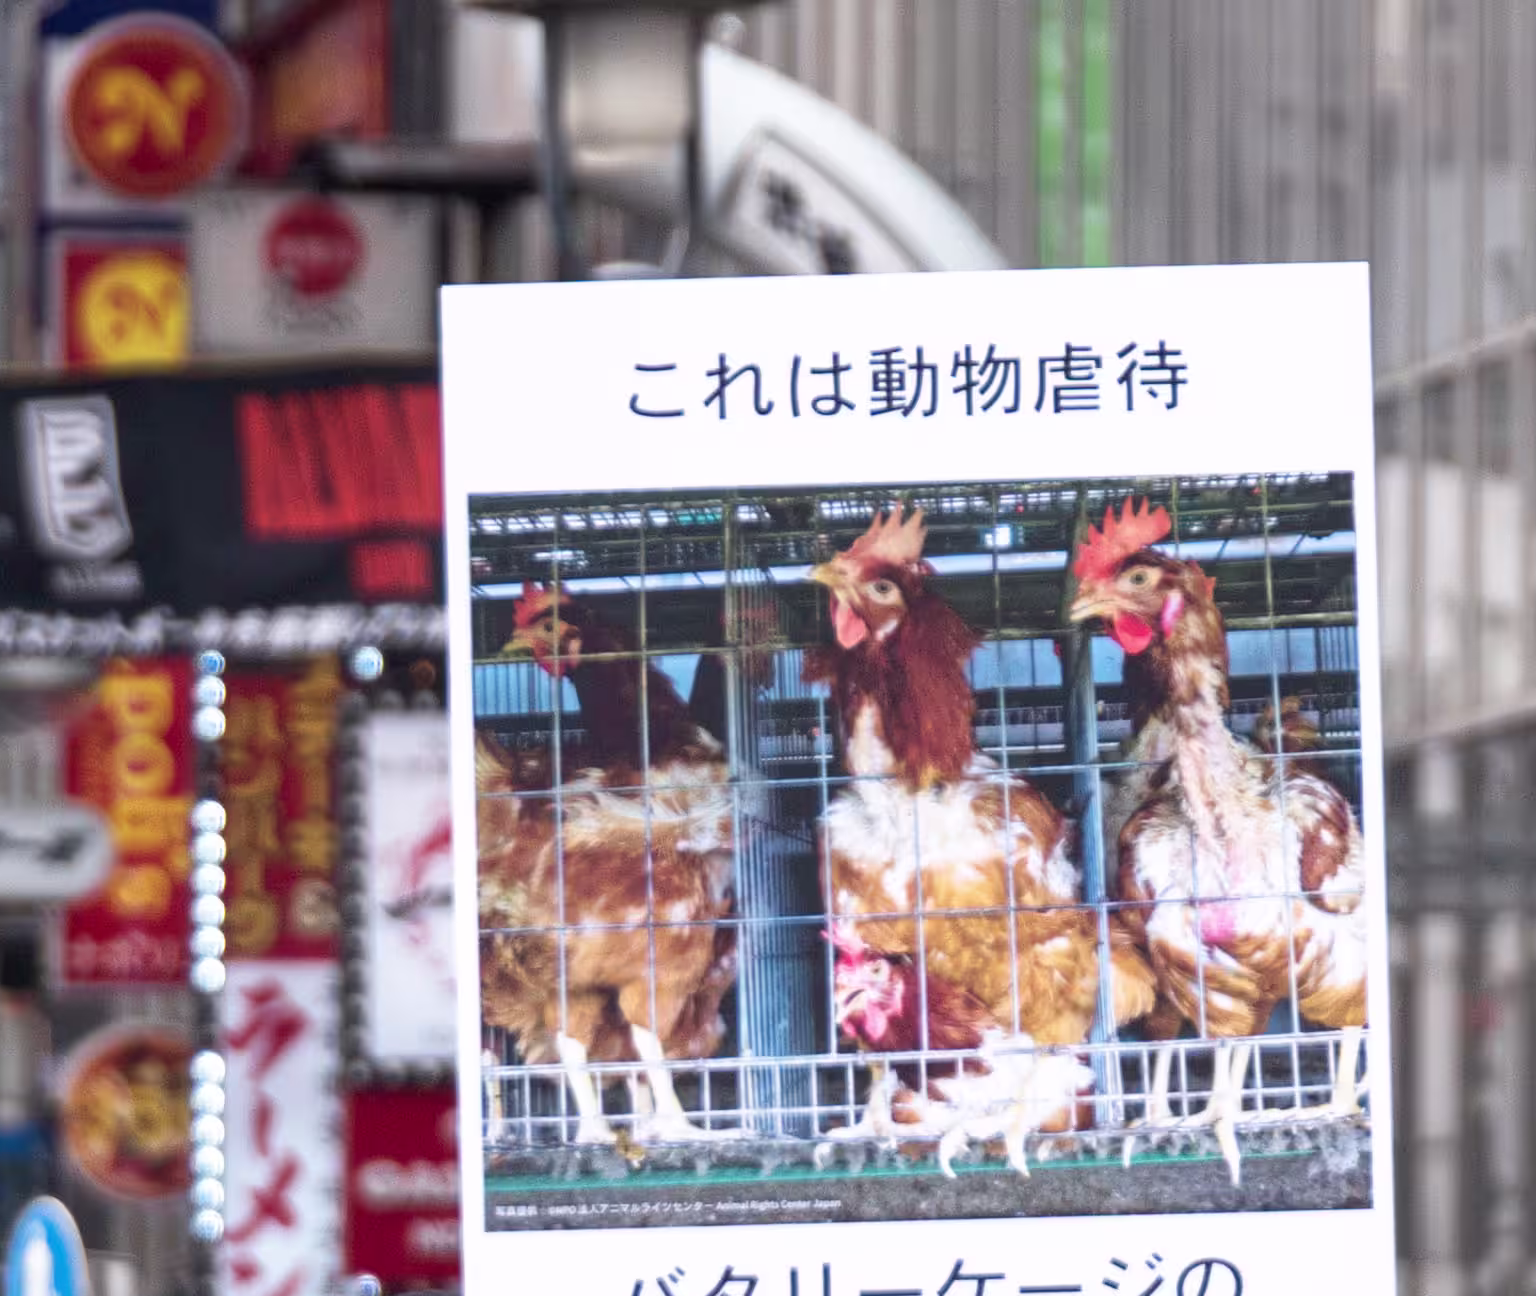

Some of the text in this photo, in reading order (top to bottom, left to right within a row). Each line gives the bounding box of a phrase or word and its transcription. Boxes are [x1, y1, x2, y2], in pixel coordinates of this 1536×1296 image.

[629, 340, 1189, 420] これは動物虐待
